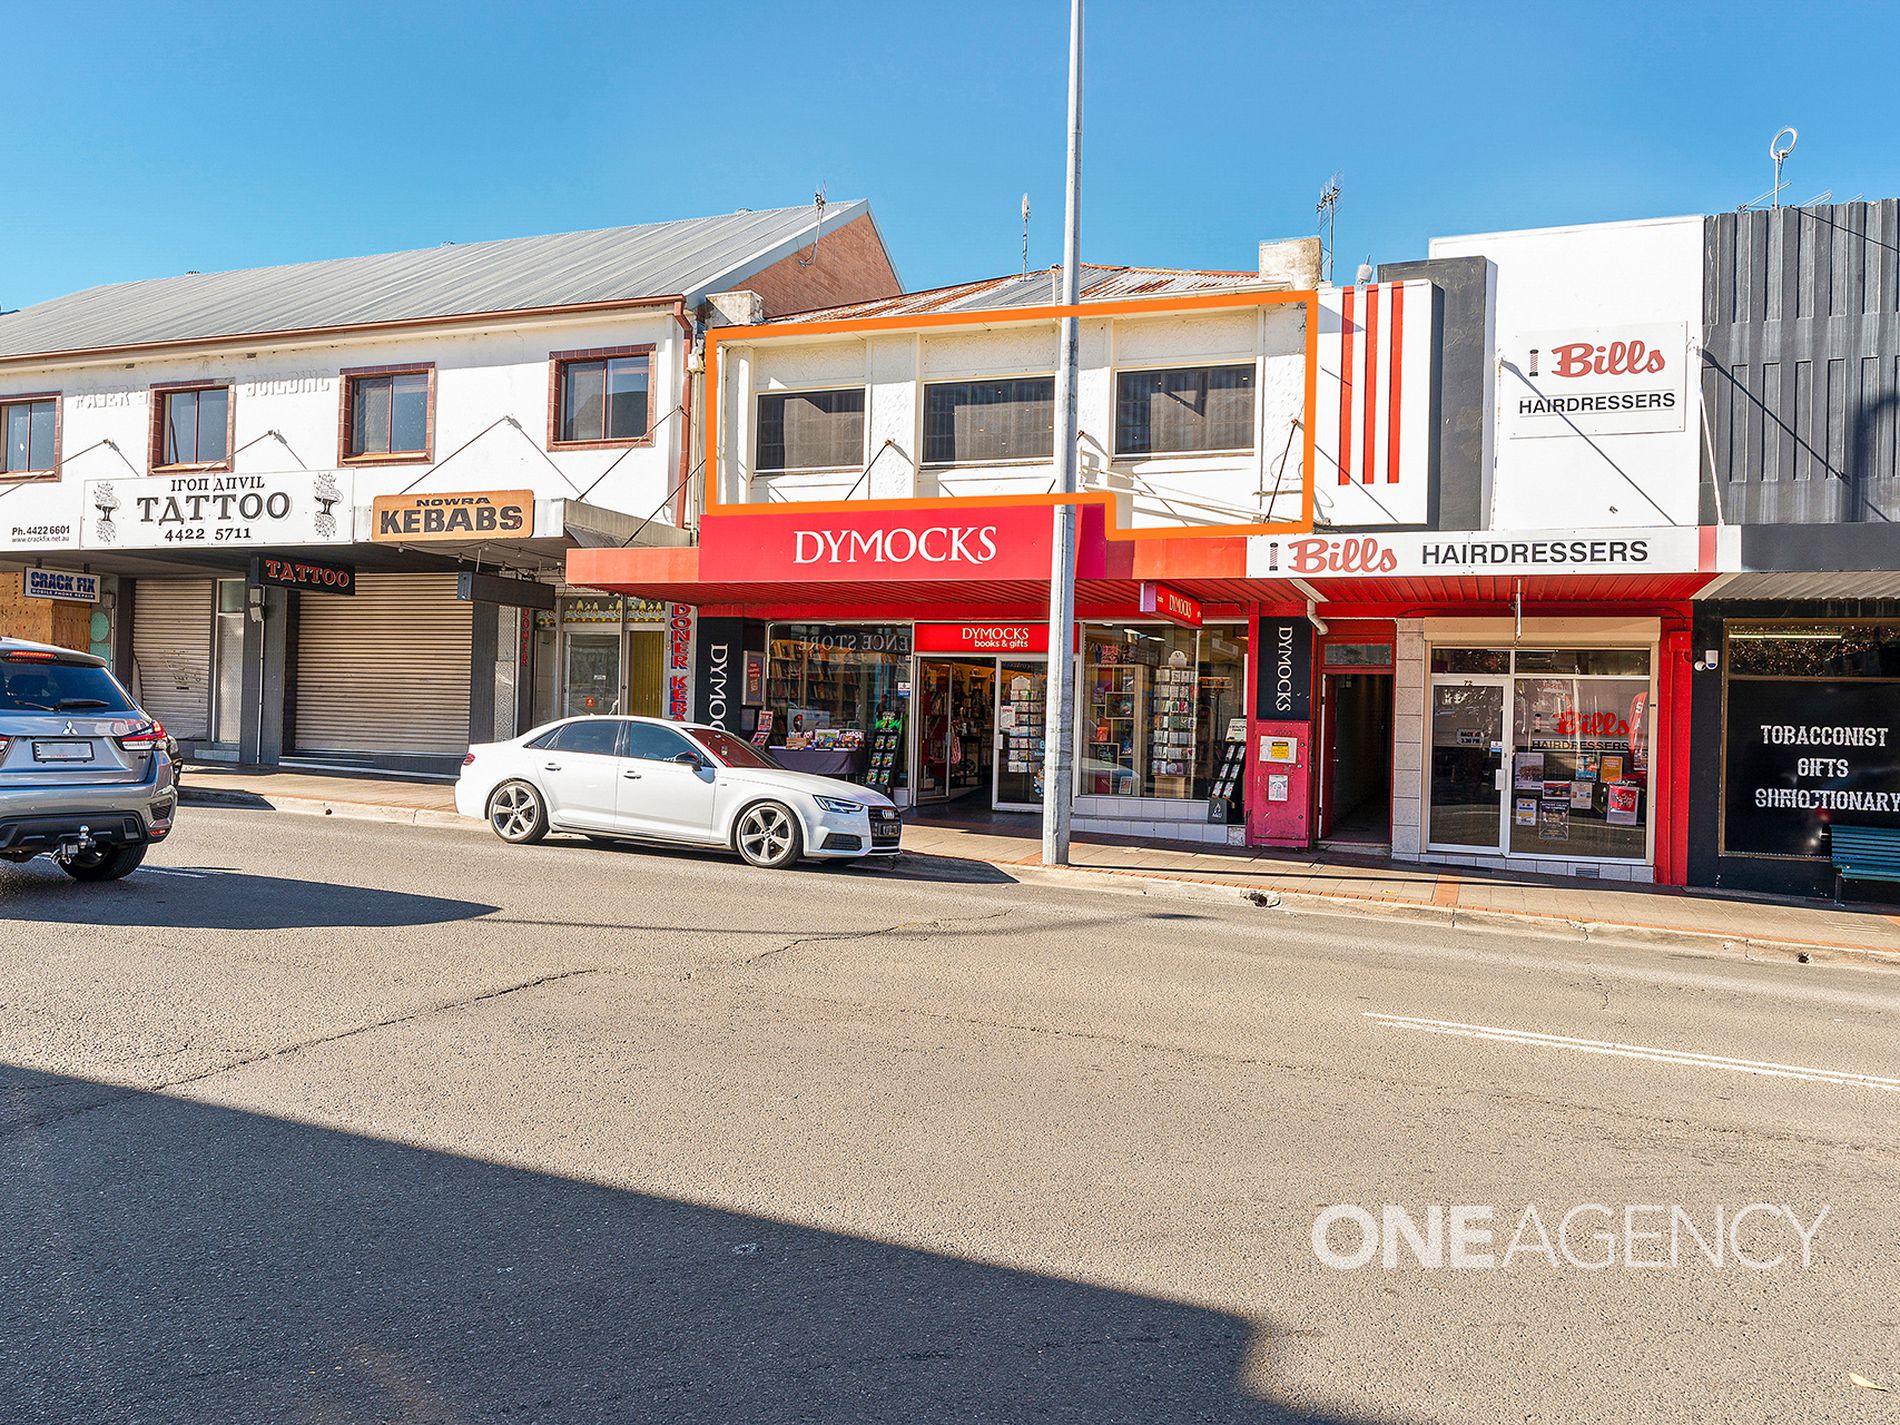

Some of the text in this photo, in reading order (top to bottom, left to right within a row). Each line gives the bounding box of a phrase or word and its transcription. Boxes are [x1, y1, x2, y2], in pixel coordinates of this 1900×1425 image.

[1551, 340, 1666, 378] Bills
[1519, 392, 1675, 414] HAIRDRESSERS
[137, 491, 291, 526] TATTOO
[416, 497, 491, 507] NOWRA
[380, 506, 524, 535] KEBABS
[164, 527, 251, 542] 4422 5711
[793, 526, 997, 564] DYMOCKS
[1287, 538, 1649, 573] Bills HAIRDRESSERS
[31, 572, 96, 593] CRACK FIX
[265, 559, 350, 588] TATTOO
[671, 603, 692, 669] DONER
[962, 627, 1029, 641] DYMOCKS
[974, 639, 1029, 649] books & gifts
[1275, 626, 1293, 712] DYMOCKS
[1553, 711, 1630, 736] Bills
[1532, 740, 1630, 752] HAIRDRESSERS
[1760, 725, 1889, 747] TOBACCONIST
[1797, 758, 1850, 778] GIFTS
